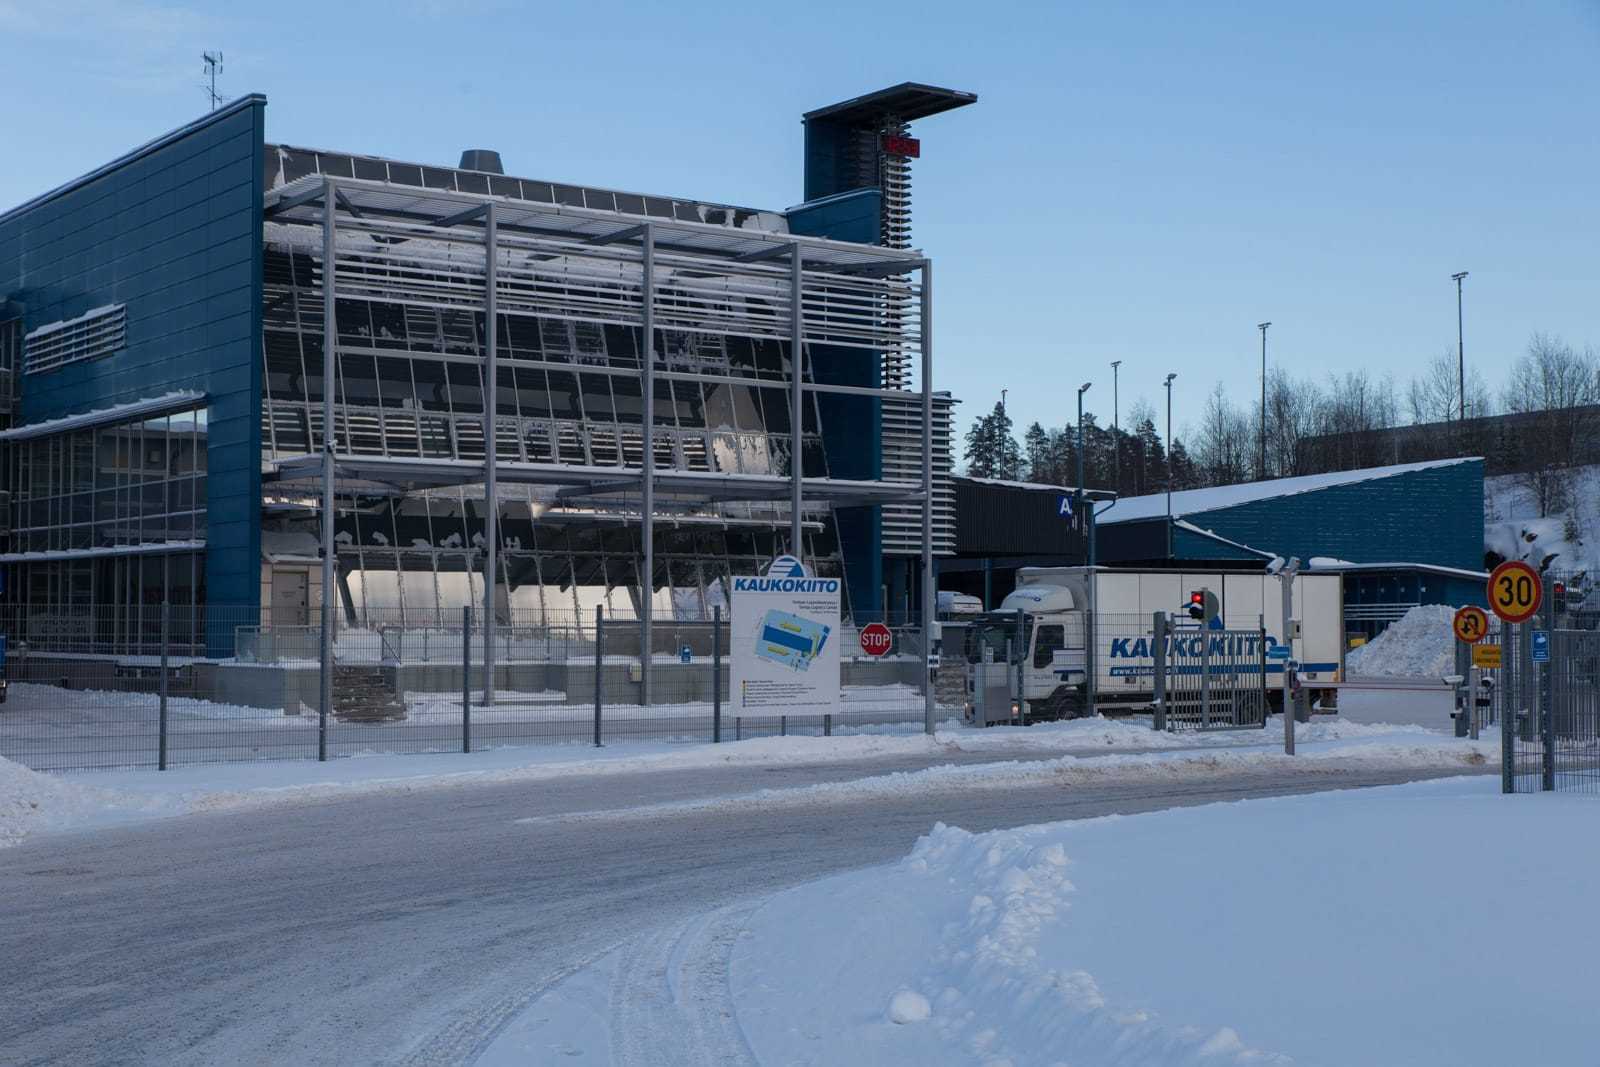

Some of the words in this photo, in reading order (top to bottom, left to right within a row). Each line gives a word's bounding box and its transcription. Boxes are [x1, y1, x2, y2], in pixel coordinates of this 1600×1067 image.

[1059, 497, 1072, 514] A
[734, 578, 838, 593] KAUKOKIITO
[1499, 576, 1532, 607] 30
[862, 634, 890, 646] STOP
